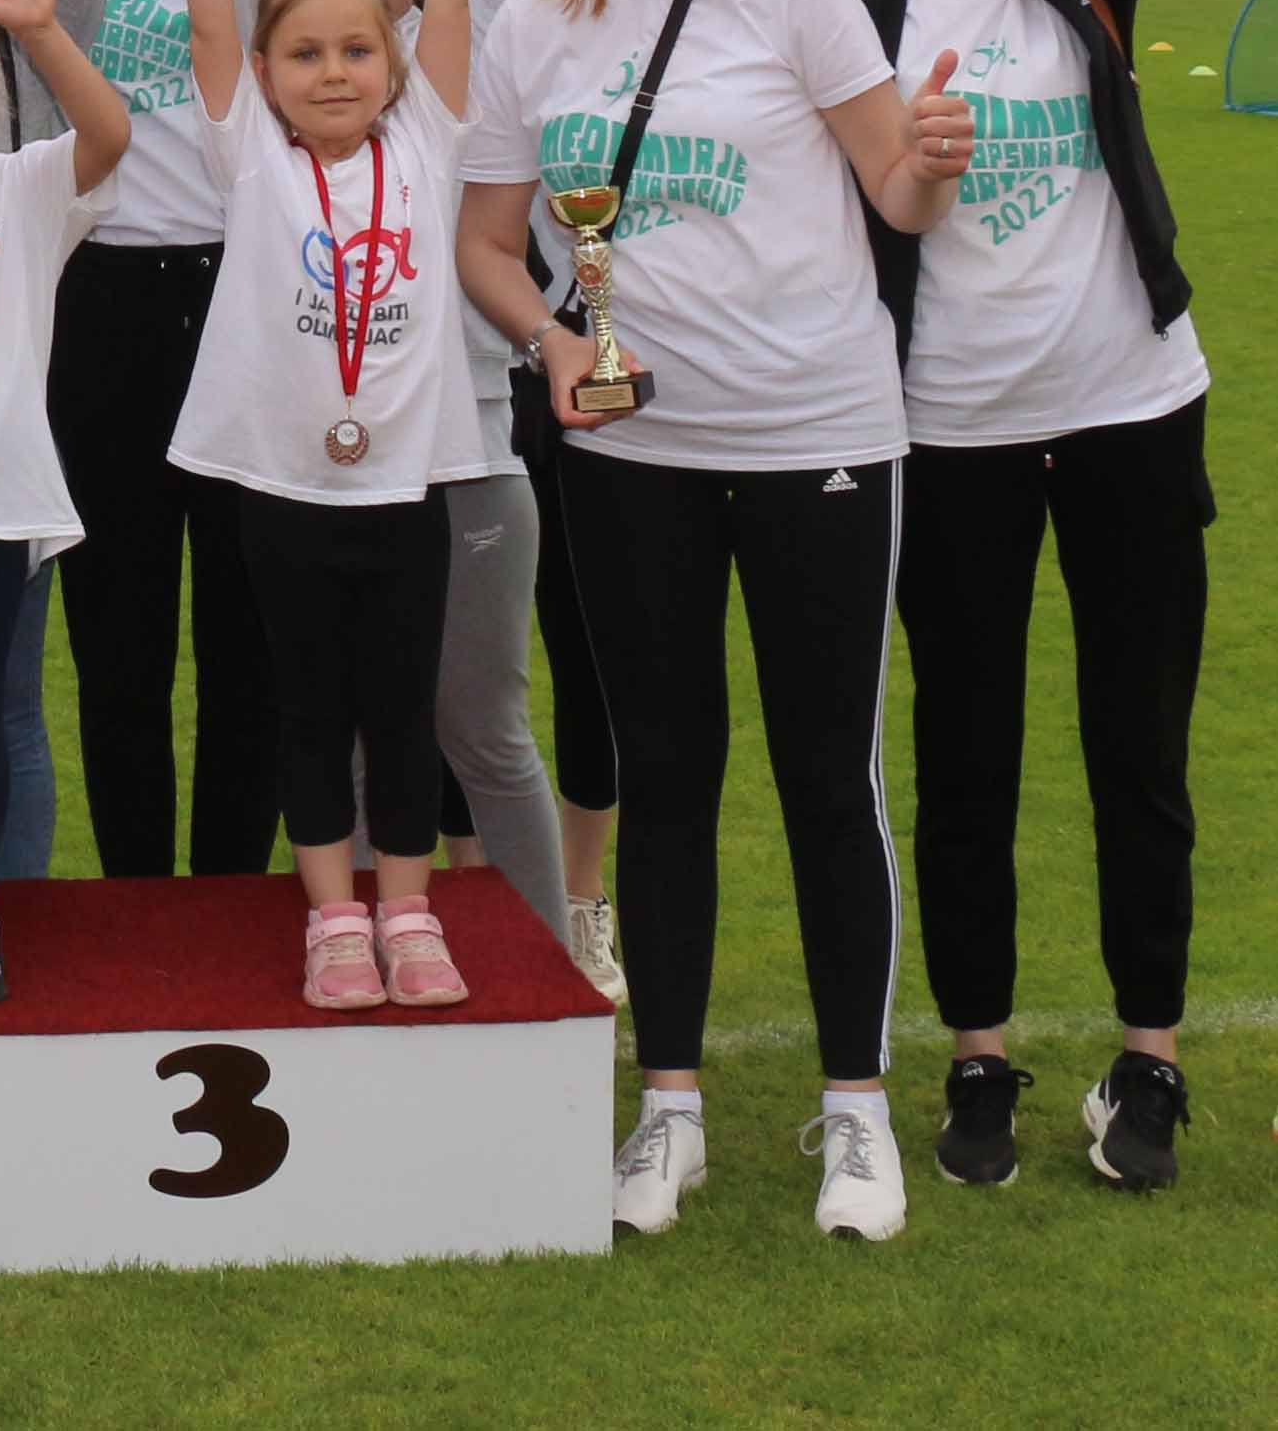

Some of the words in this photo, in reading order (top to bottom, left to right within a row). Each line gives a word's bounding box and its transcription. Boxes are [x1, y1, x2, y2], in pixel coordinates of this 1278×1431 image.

[613, 200, 685, 240] 022.
[980, 173, 1072, 246] 2022.
[308, 292, 331, 314] JA
[373, 302, 409, 322] BITI
[297, 315, 403, 346] OLIPJAC
[148, 1043, 290, 1199] 3
